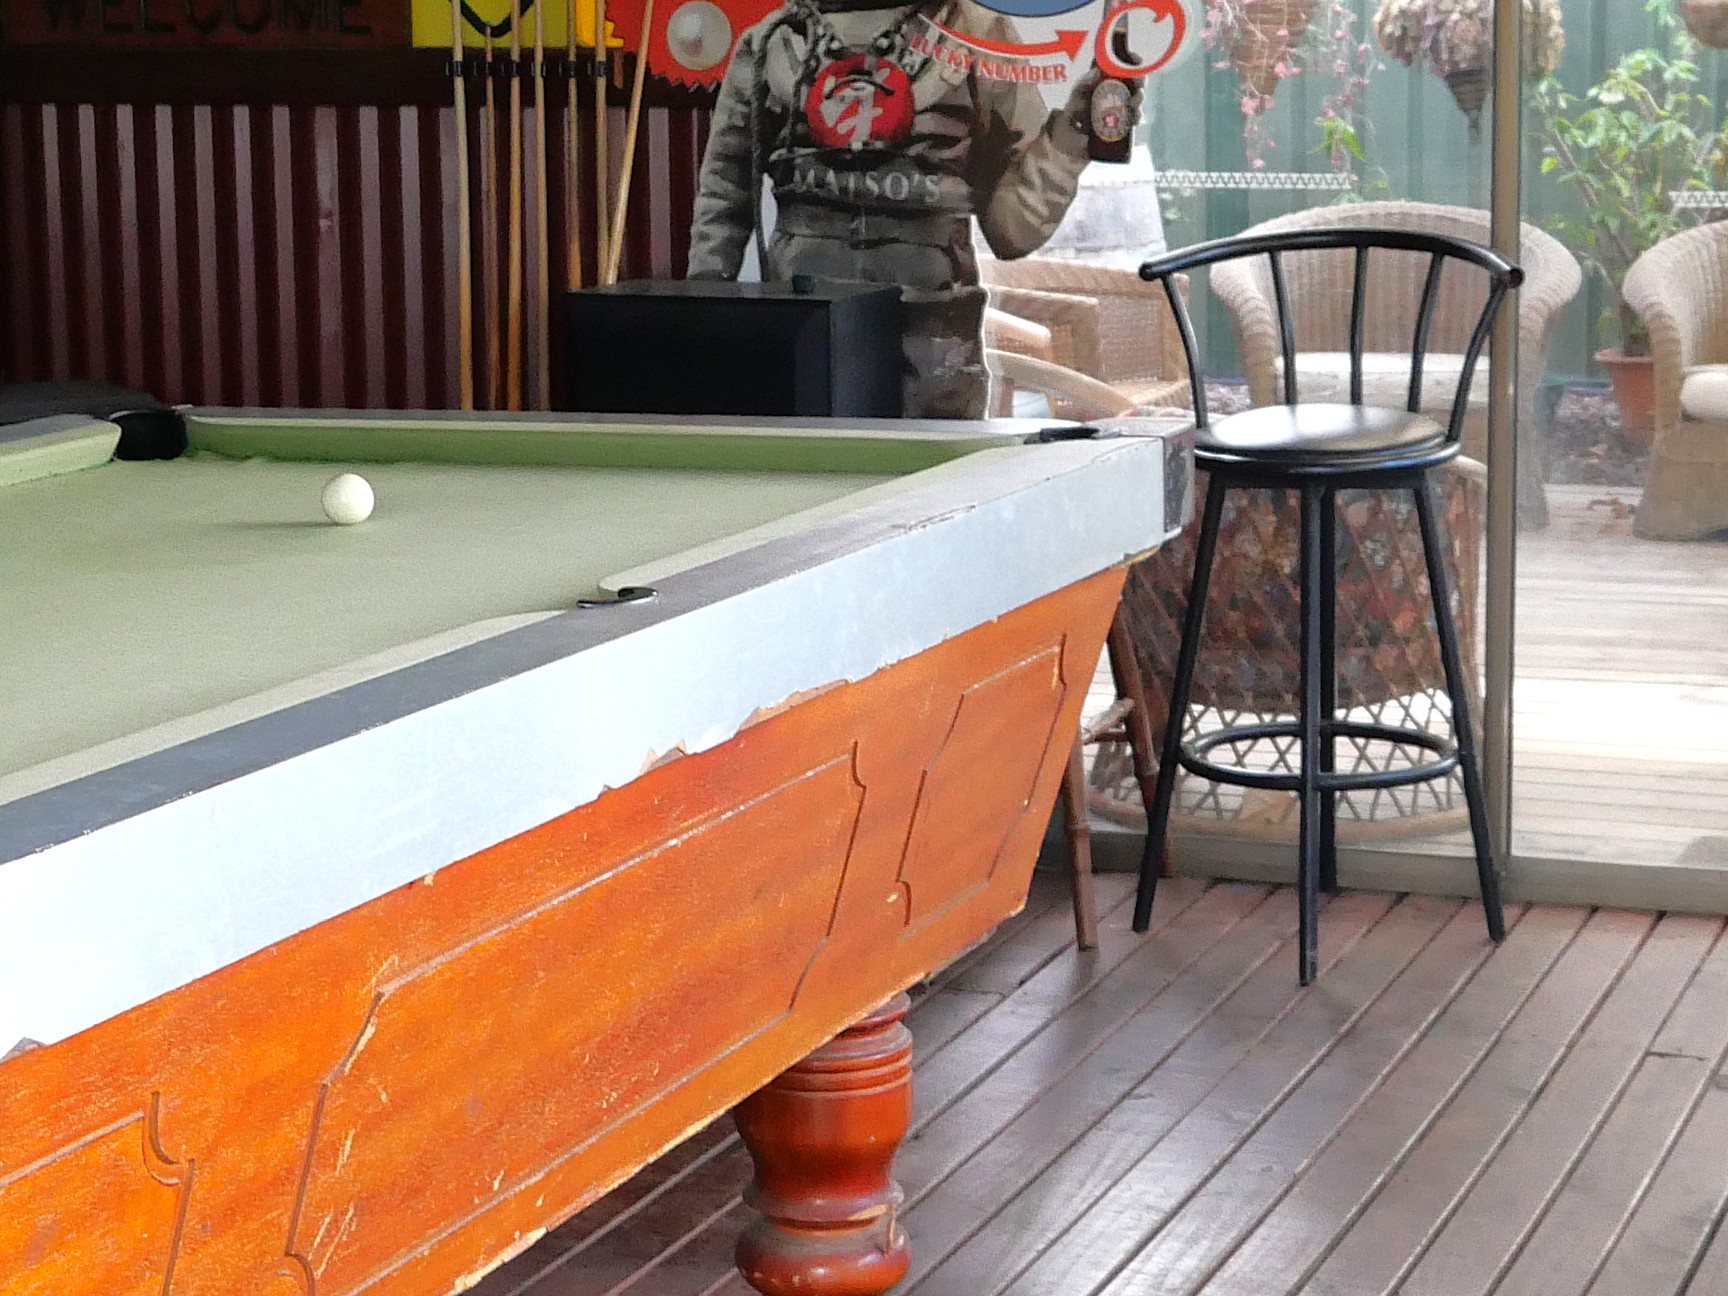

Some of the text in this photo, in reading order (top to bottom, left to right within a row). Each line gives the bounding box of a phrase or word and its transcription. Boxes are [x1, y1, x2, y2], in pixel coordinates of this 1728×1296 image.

[909, 34, 1067, 83] LUCKY NUMBER
[792, 168, 940, 203] MATSO'S
